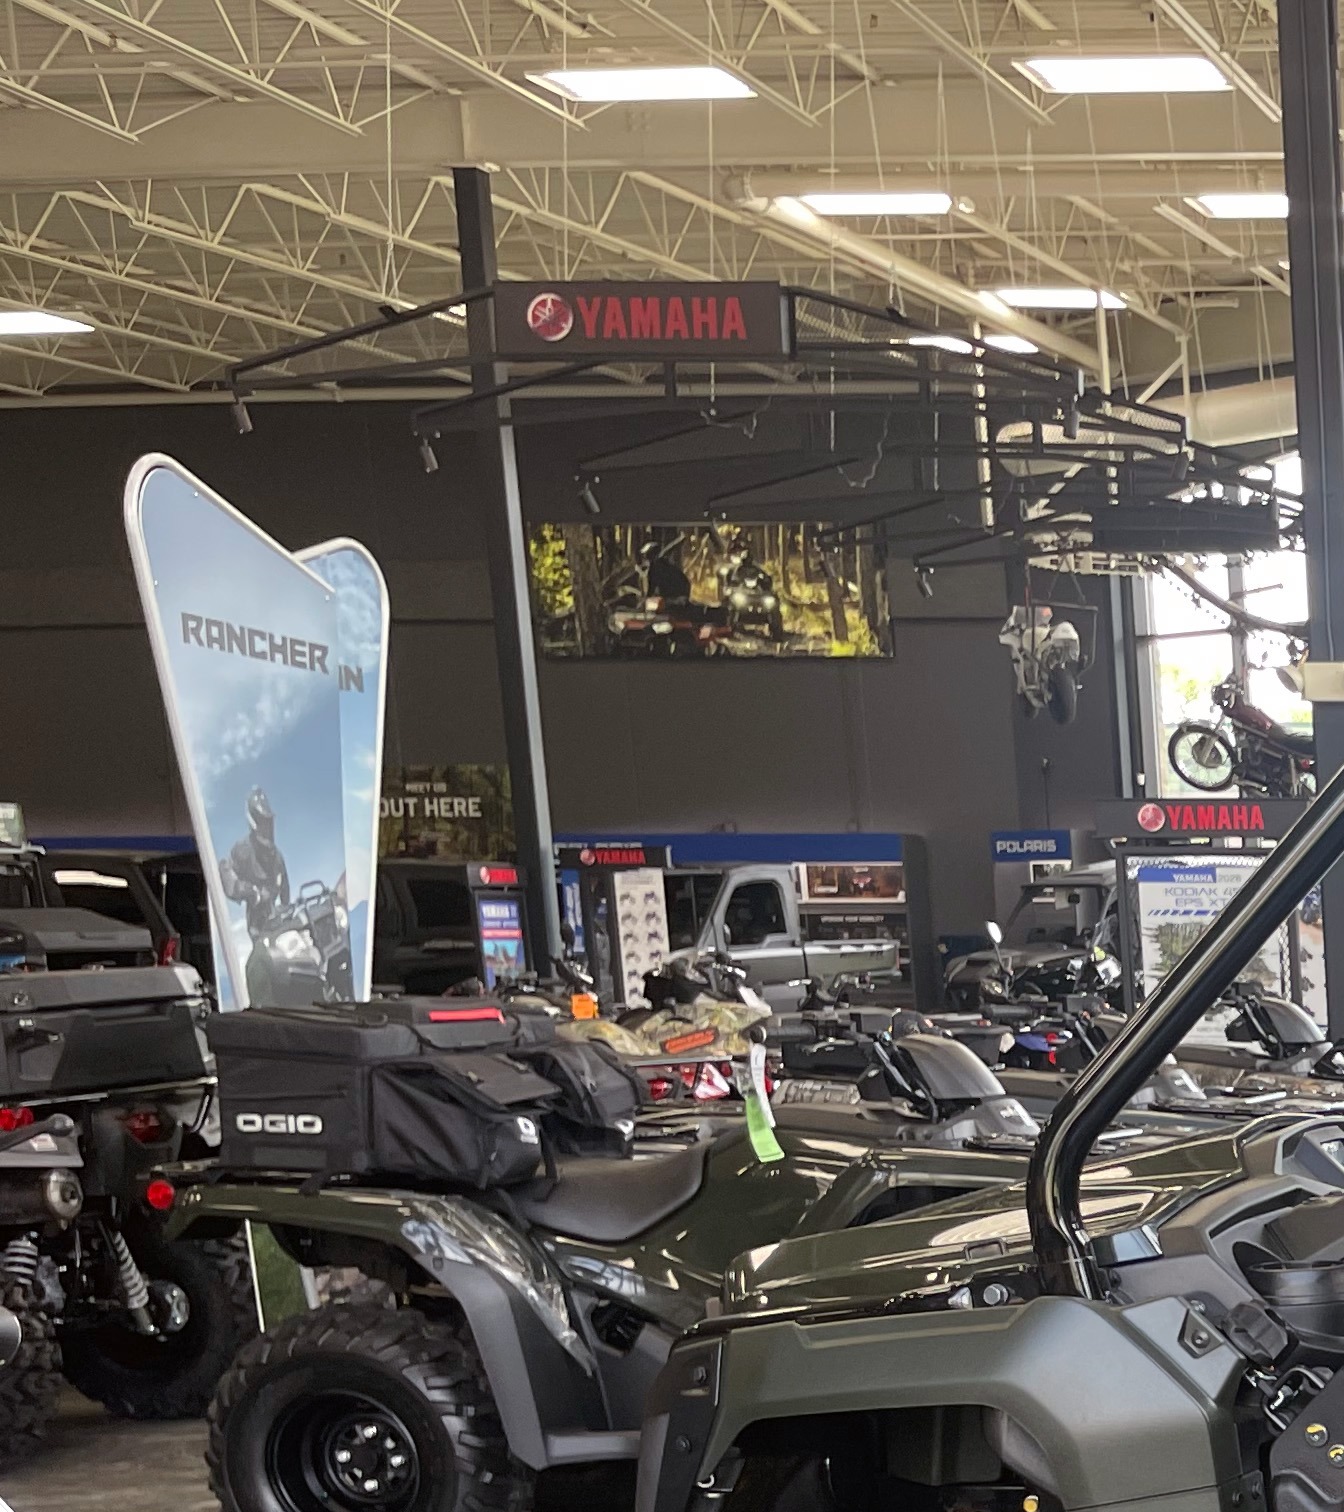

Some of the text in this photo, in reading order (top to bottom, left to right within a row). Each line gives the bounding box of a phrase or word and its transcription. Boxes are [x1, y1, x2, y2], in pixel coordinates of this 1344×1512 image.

[576, 296, 747, 339] YAMAHA
[181, 612, 330, 675] RANCHER
[424, 796, 482, 818] HERE
[1166, 805, 1264, 830] YAMAHA
[996, 839, 1057, 853] POLARIS
[1173, 873, 1214, 883] YAMAHA
[1164, 887, 1217, 897] KODIAK
[236, 1113, 323, 1135] OGIO
